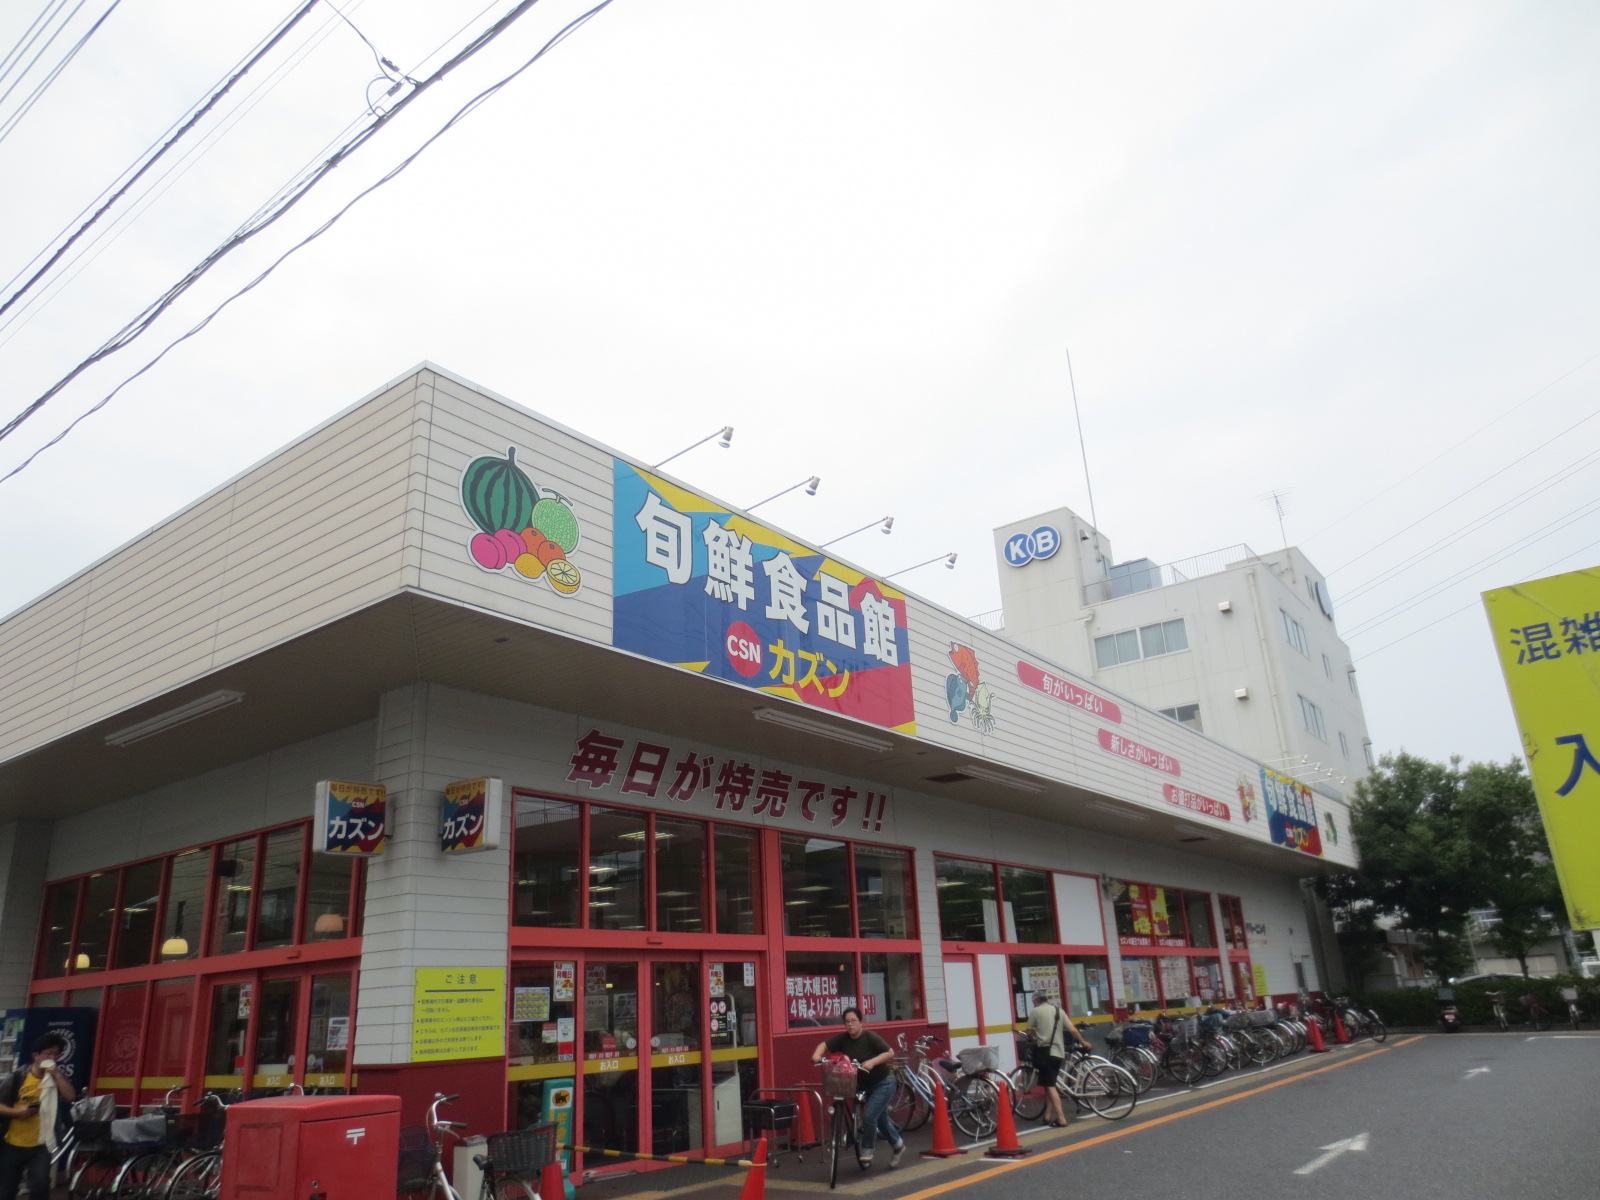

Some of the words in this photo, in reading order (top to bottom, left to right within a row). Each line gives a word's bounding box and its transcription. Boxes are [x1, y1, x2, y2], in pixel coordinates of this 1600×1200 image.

[1009, 530, 1055, 561] KB
[634, 490, 899, 667] 旬鮮食品館
[727, 634, 761, 664] CSN
[768, 639, 850, 698] カズン
[1042, 674, 1103, 713] 旬がいっぱい
[1110, 734, 1173, 771] 新しさがいっぱい
[566, 728, 887, 833] 毎日が特売です!!
[351, 801, 365, 809] CSN
[328, 816, 384, 841] カズン
[442, 813, 484, 840] カズン
[445, 973, 477, 984] ご注意
[786, 975, 838, 997] 毎週木曜日は
[599, 1060, 619, 1072] お入口
